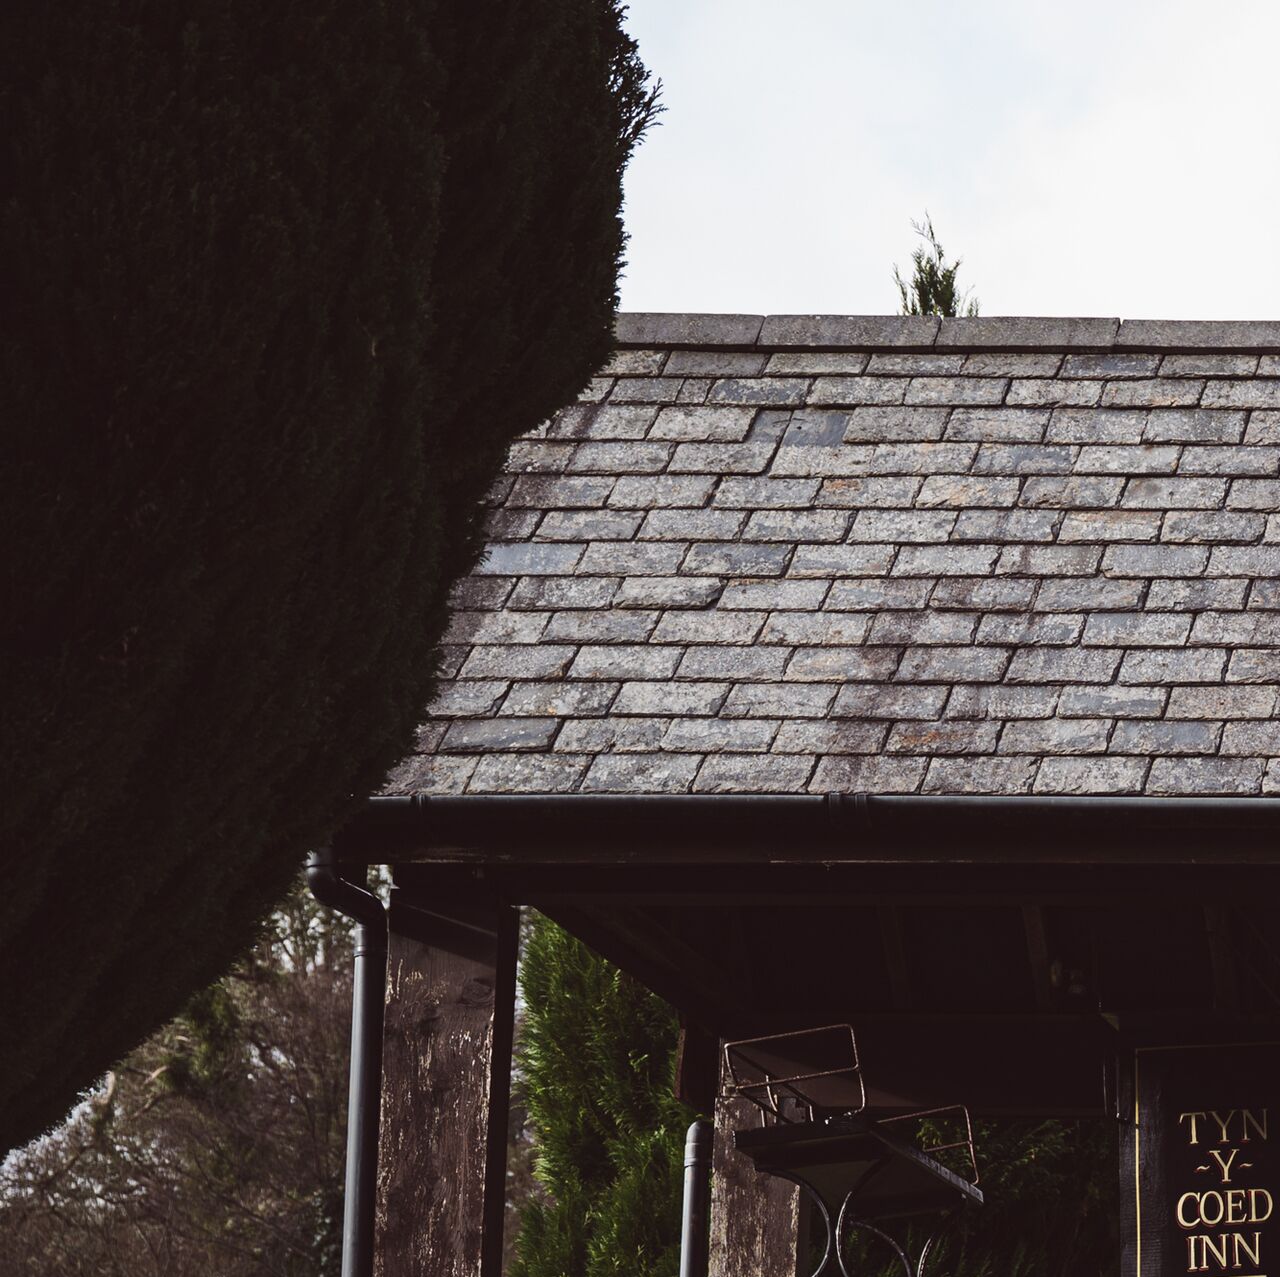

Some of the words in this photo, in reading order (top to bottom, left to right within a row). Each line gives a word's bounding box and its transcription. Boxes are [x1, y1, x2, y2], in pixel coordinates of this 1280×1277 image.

[1179, 1109, 1268, 1145] TYN
[1175, 1189, 1273, 1229] COED
[1186, 1232, 1262, 1272] INN
